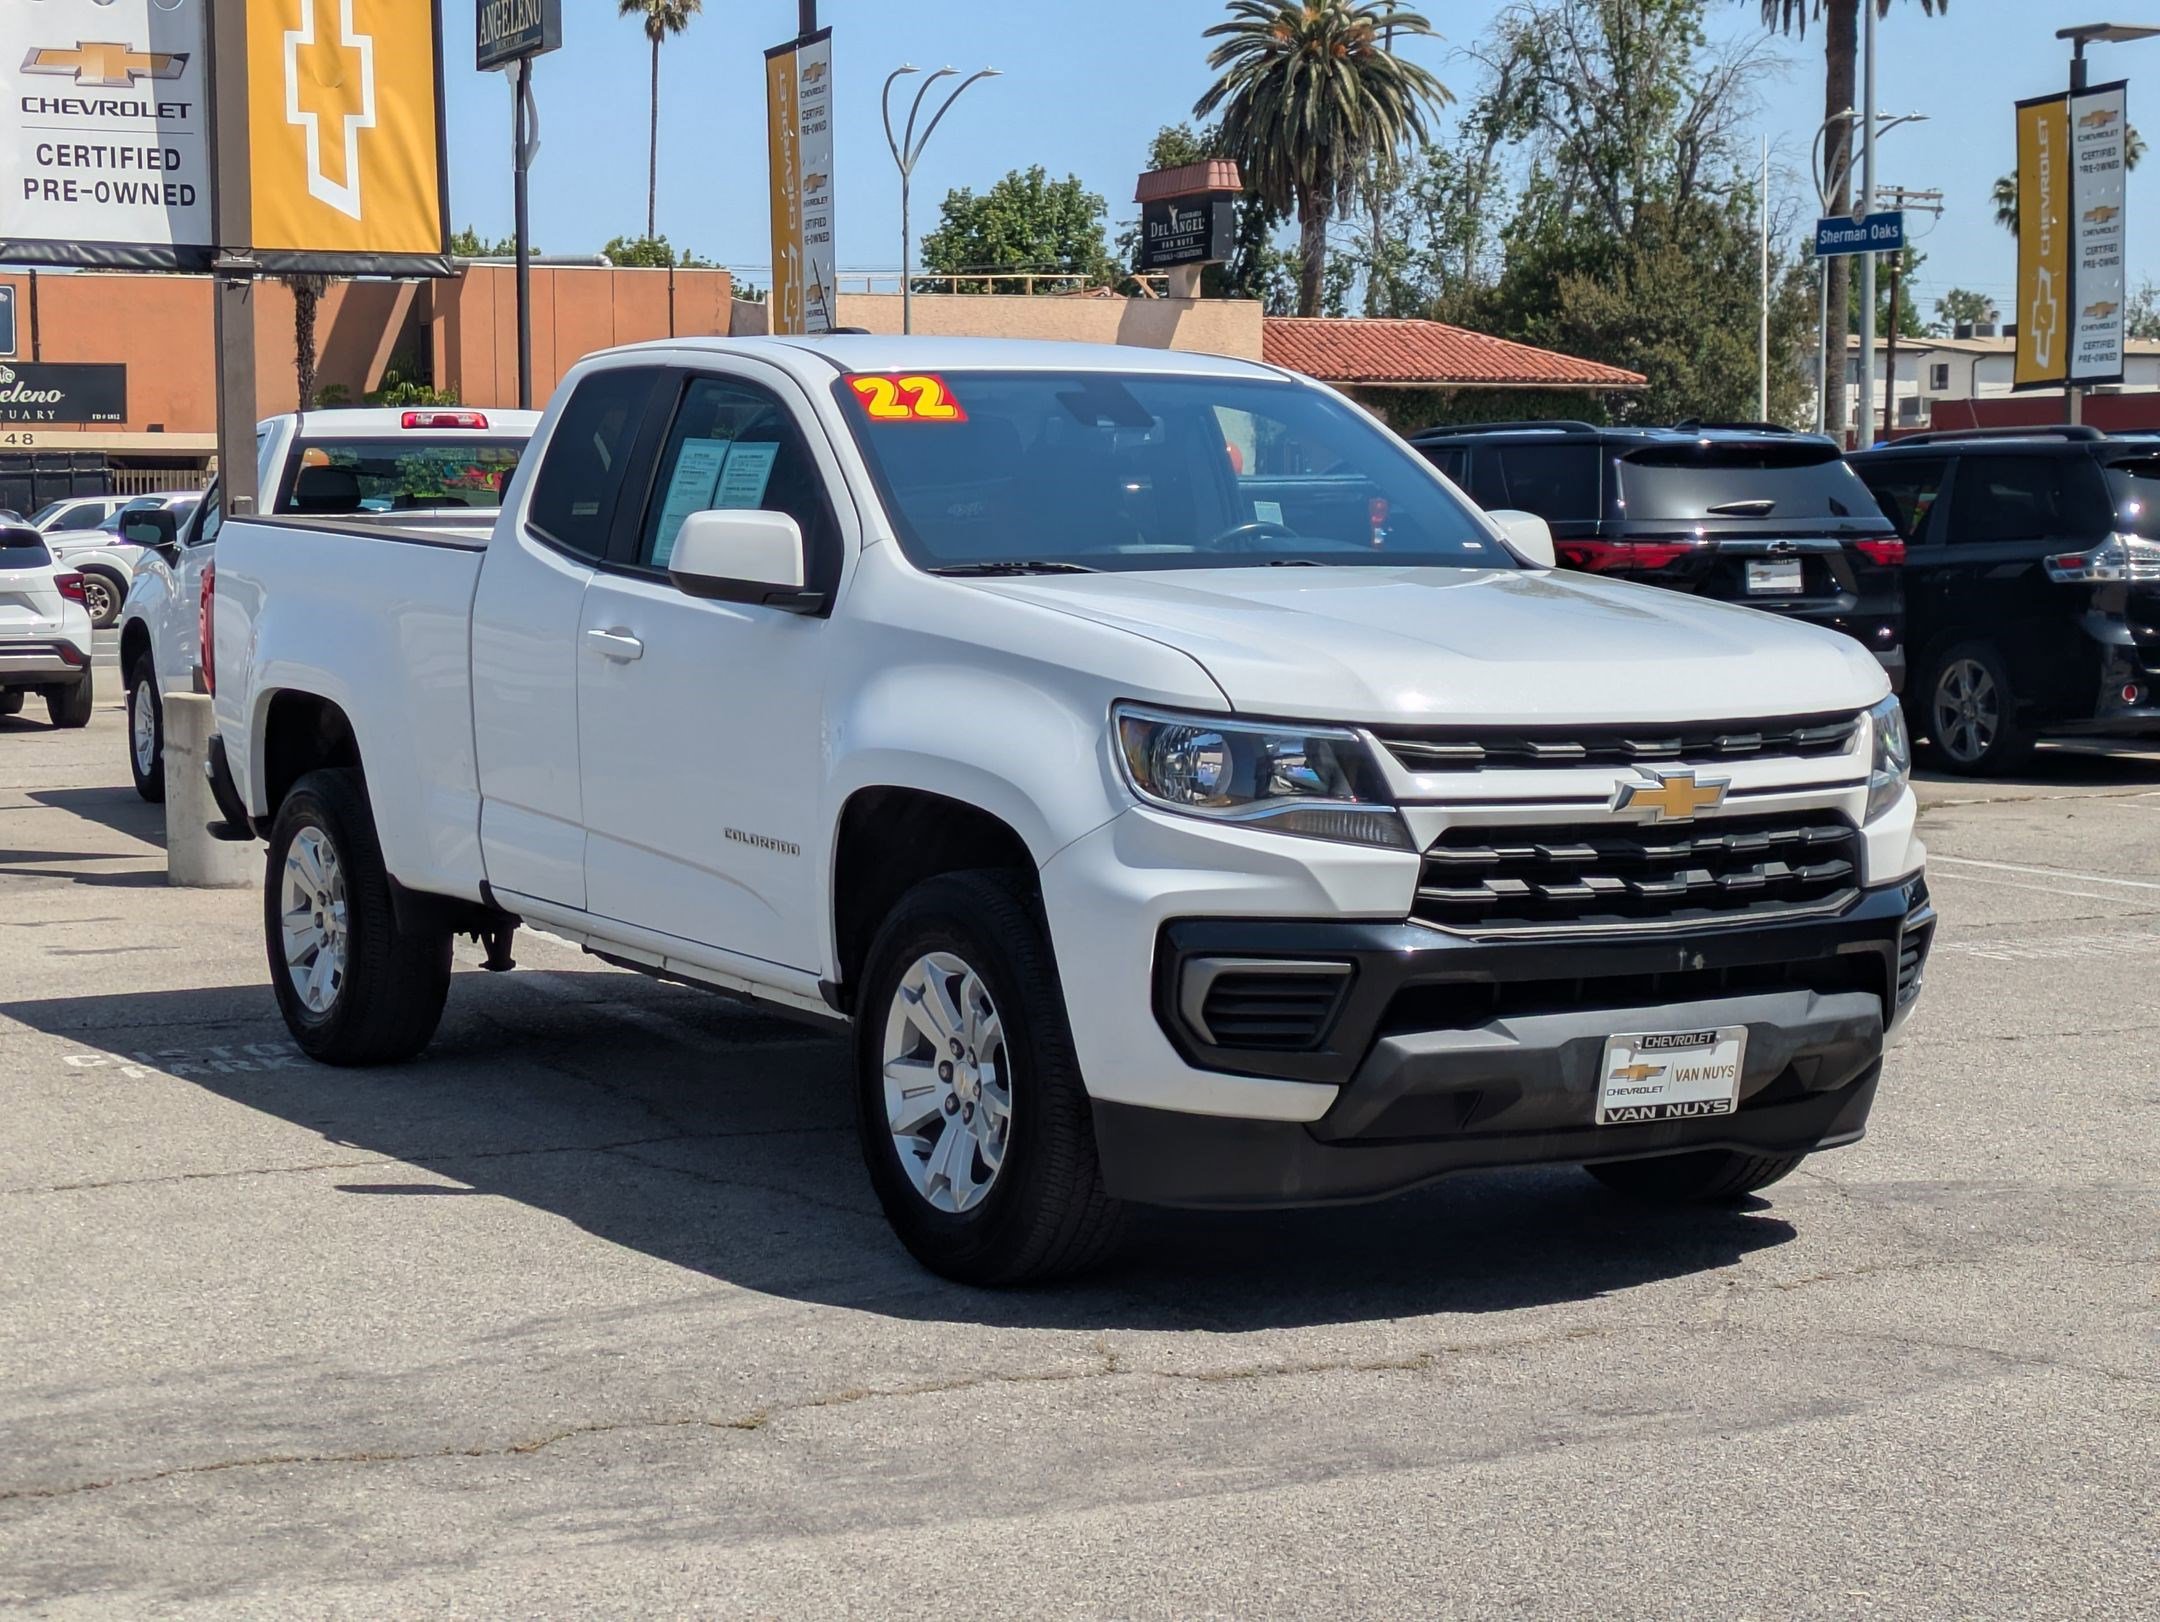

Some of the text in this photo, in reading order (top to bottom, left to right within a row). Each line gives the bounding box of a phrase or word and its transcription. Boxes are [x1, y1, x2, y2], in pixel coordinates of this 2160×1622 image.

[479, 0, 541, 47] ANGELENO
[21, 97, 192, 119] CHEVROLET
[2078, 129, 2118, 142] CHEVROLET
[36, 143, 181, 171] CERTIFIED
[2081, 147, 2116, 161] CERTIFIED
[2080, 160, 2119, 174] PRE-OWNED
[23, 178, 196, 207] PRE-OWNED
[2038, 117, 2050, 256] CHEVROLET
[1819, 224, 1899, 245] Sherman Oaks
[2083, 225, 2119, 237] CHEVROLET
[2086, 243, 2117, 256] CERTIFIED
[2083, 256, 2119, 269] PRE-OWNED
[2081, 321, 2117, 332] CHEVROLET
[2083, 339, 2115, 351] CERTIFIED
[2078, 352, 2117, 363] PRE-OWNED
[0, 381, 66, 403] eleno
[852, 376, 958, 419] 22
[724, 826, 800, 857] COLORADO
[1644, 1032, 1714, 1048] CHEVROLET
[1676, 1064, 1735, 1082] VAN NUYS
[1606, 1085, 1664, 1097] CHEVROLET
[1606, 1100, 1729, 1121] VAN NUYS
